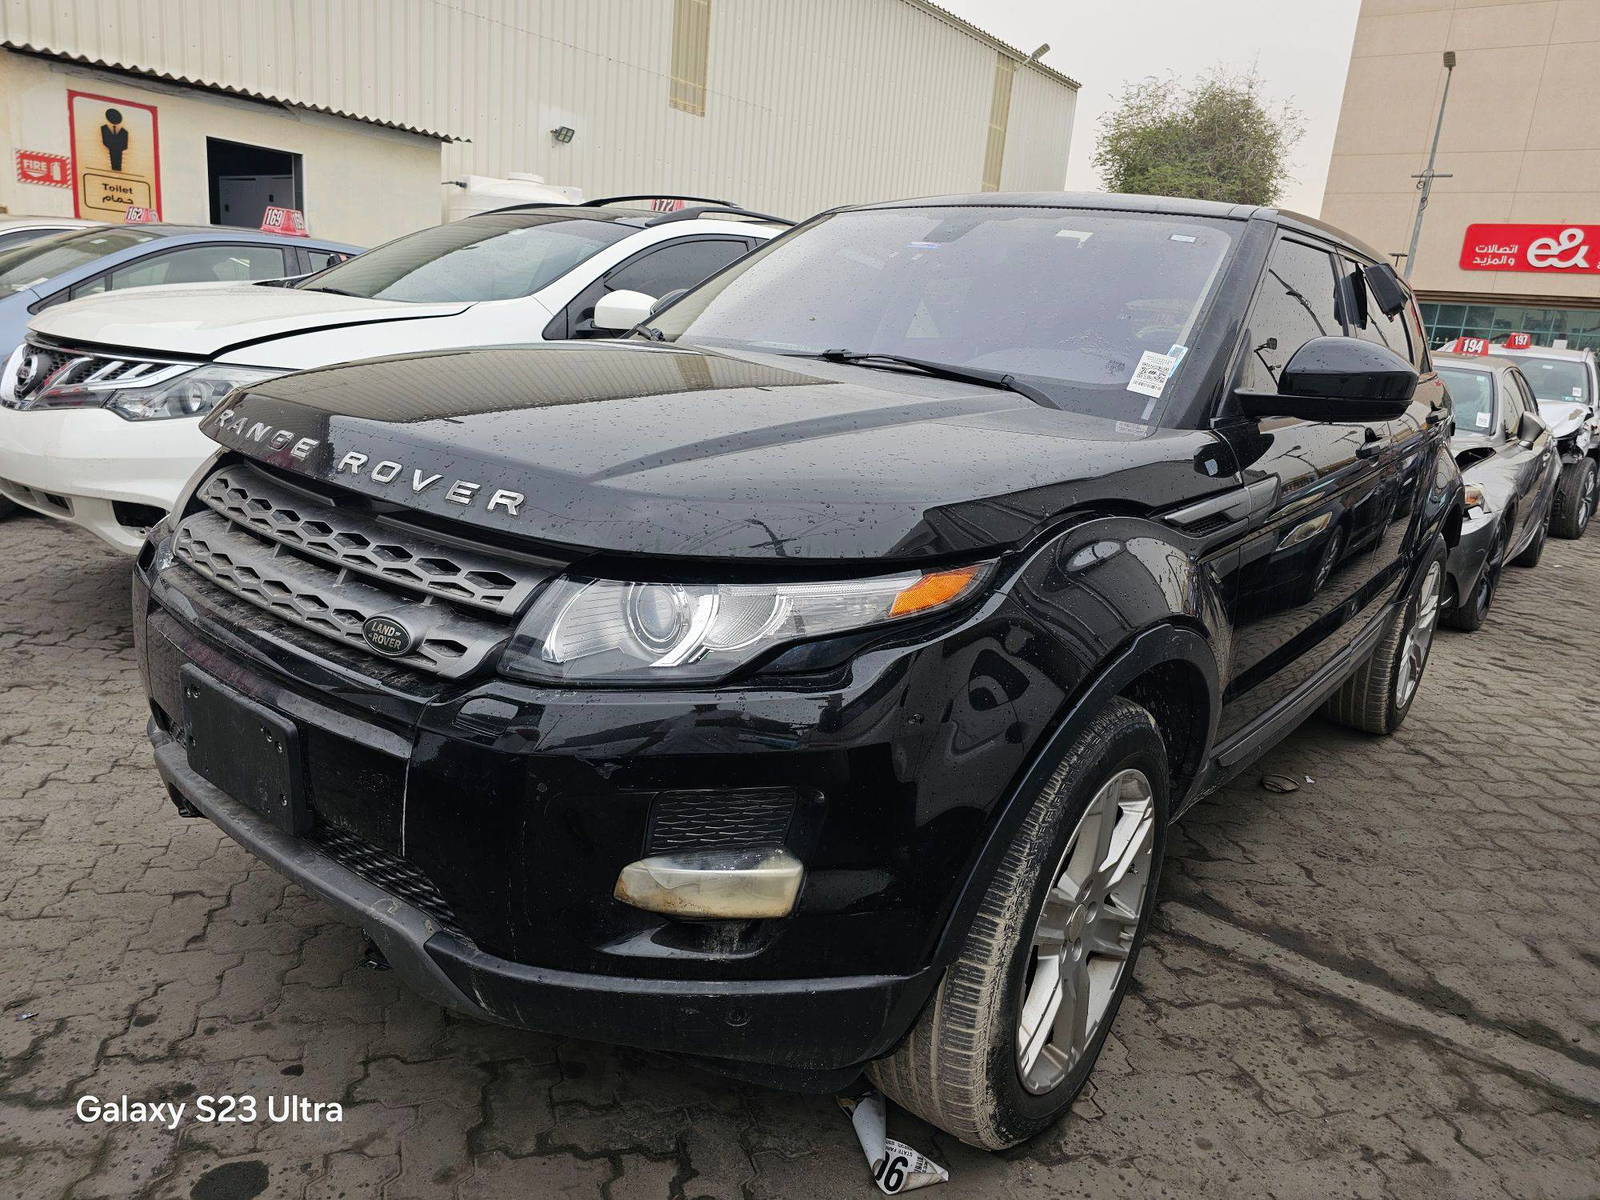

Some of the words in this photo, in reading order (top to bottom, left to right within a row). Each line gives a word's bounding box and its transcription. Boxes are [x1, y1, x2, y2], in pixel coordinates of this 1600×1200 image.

[23, 159, 47, 170] FIRE
[101, 183, 134, 194] Toilet
[102, 195, 134, 204] حمام
[655, 199, 674, 212] 172
[127, 207, 143, 220] 162
[265, 209, 283, 226] 169
[1475, 244, 1518, 254] اتصالات
[1463, 339, 1484, 353] 194
[1514, 335, 1528, 346] 197
[214, 408, 319, 460] RANGE
[338, 451, 526, 516] ROVER
[371, 621, 396, 637] LAND
[372, 632, 402, 650] ROVER
